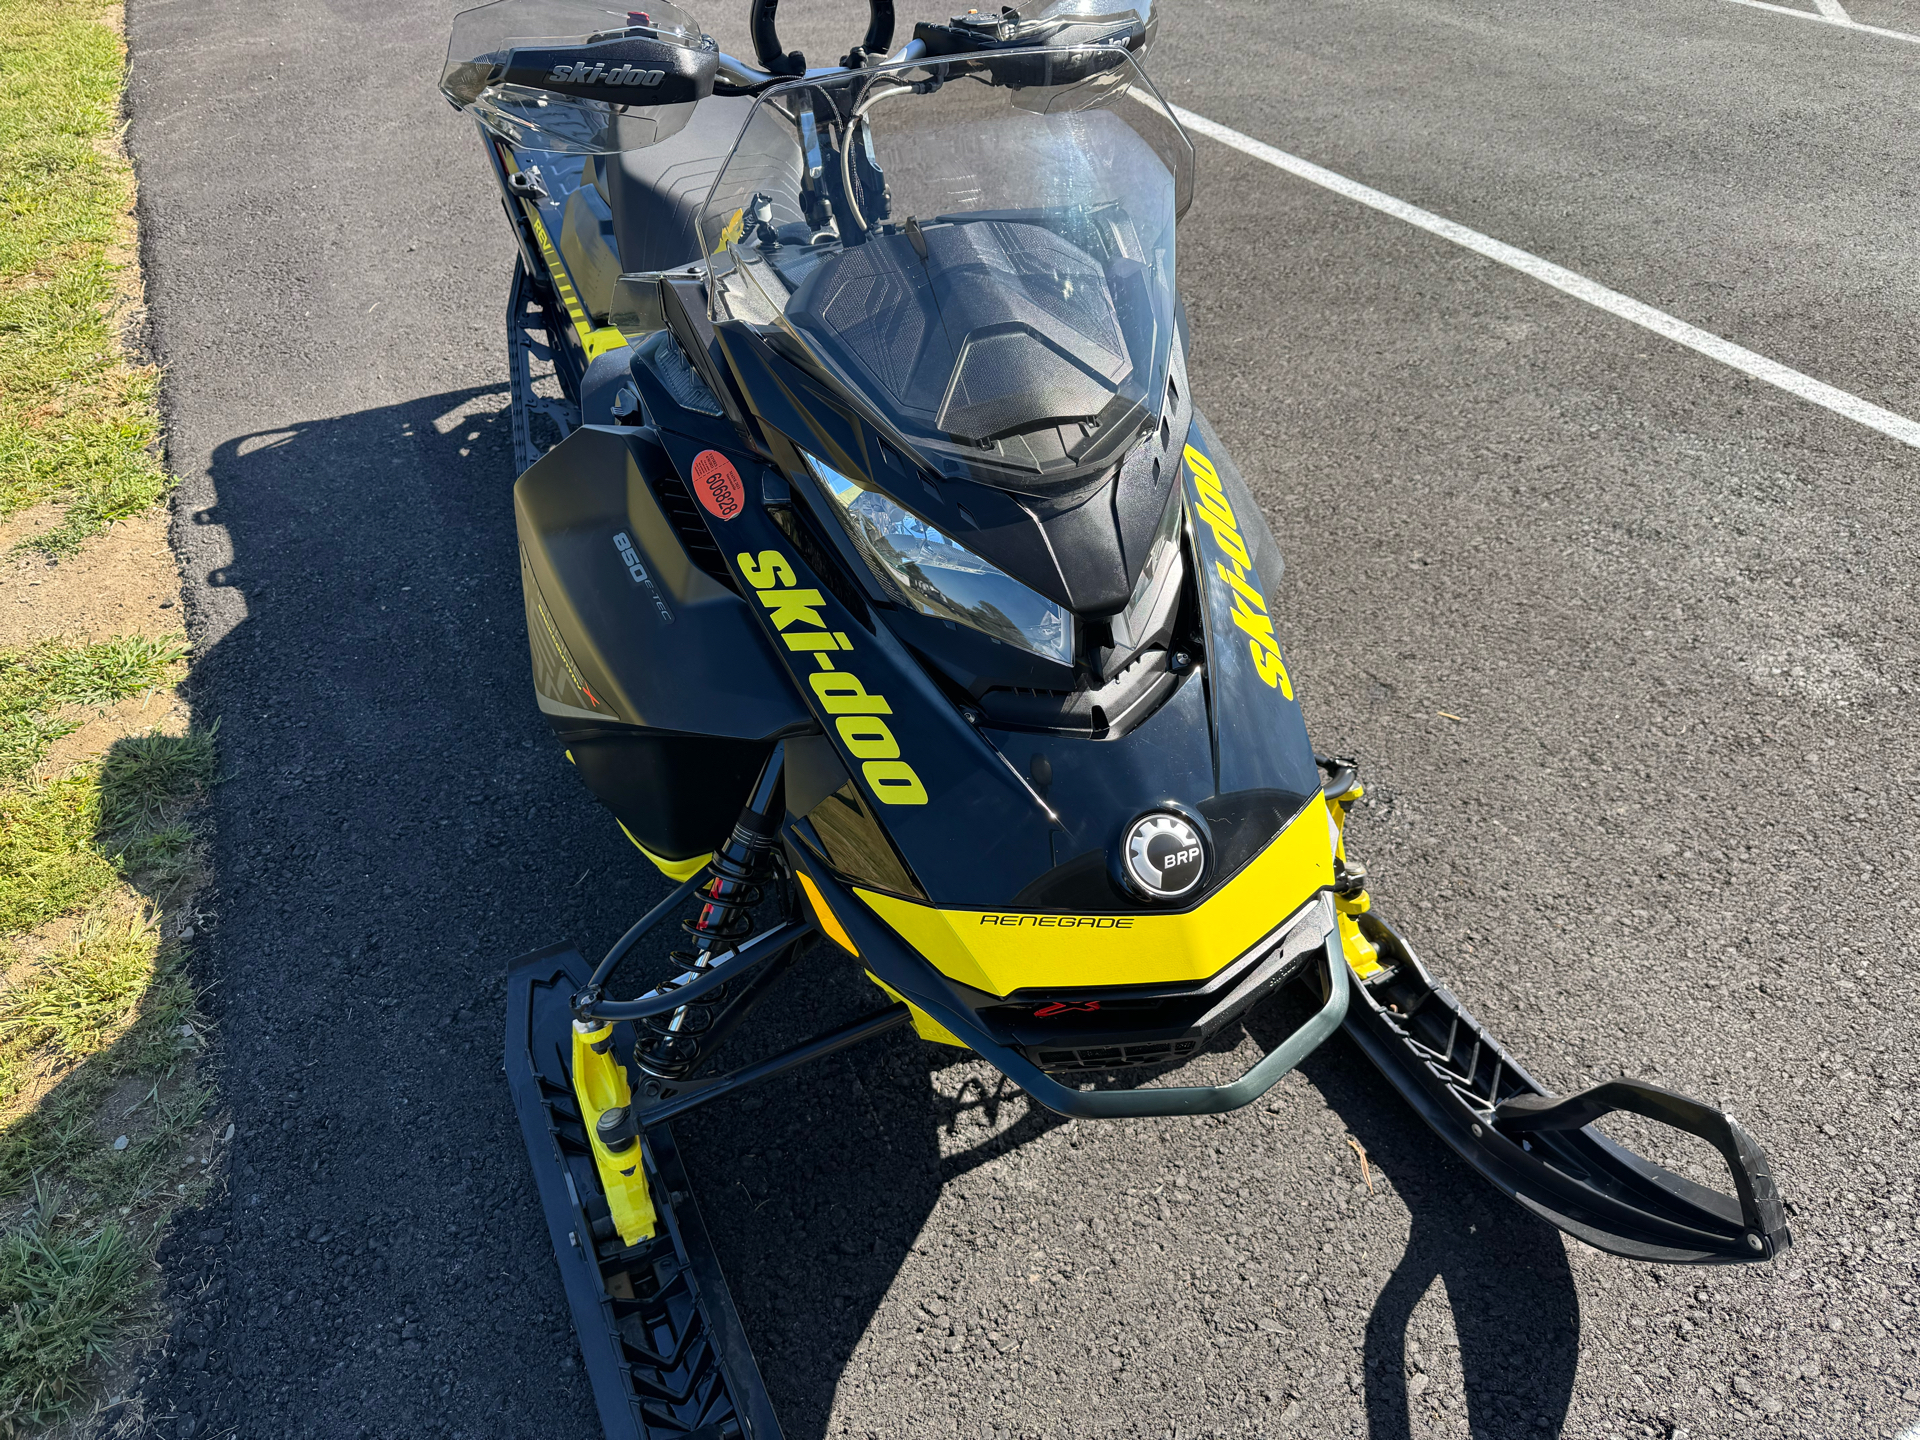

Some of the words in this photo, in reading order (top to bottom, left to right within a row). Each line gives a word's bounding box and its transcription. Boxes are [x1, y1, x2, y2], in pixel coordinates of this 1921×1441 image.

[549, 61, 666, 87] ski-doo
[533, 218, 552, 250] REV
[706, 472, 738, 515] 606828
[612, 532, 648, 583] 850
[644, 579, 672, 621] E-TEC
[1183, 443, 1294, 702] ski-doo
[737, 550, 929, 805] ski-doo
[1164, 847, 1200, 869] BRP
[980, 914, 1135, 929] RENEGADE
